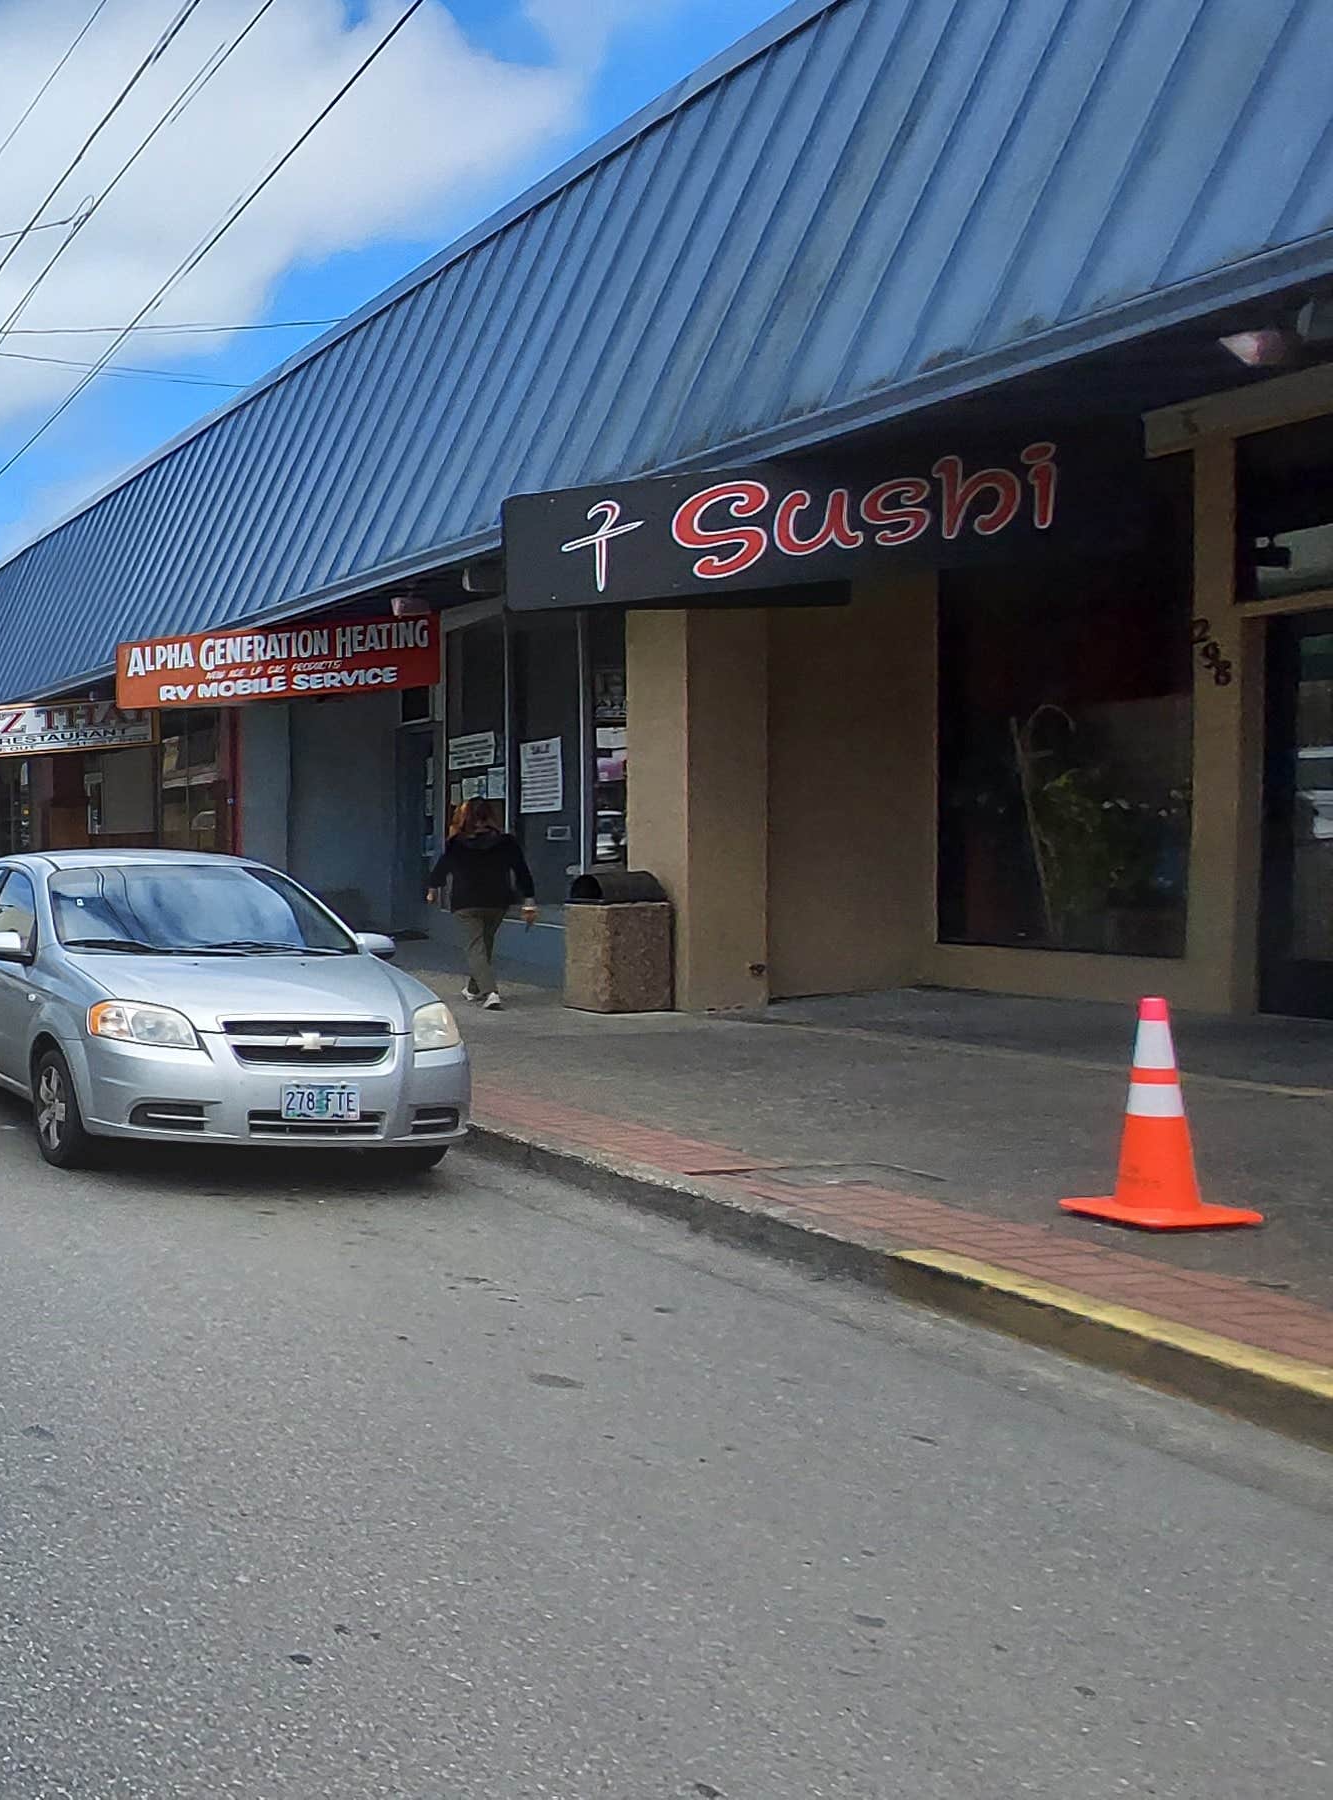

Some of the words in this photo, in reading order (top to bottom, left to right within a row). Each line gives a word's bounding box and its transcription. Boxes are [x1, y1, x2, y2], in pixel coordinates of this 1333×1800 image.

[672, 441, 1057, 579] Sushi
[127, 642, 194, 677] ALPHA
[199, 629, 329, 671] GENERATION
[336, 619, 429, 659] HEATING
[1189, 619, 1231, 686] 298
[291, 660, 342, 672] PRODUCTS
[159, 684, 194, 702] RV
[198, 675, 287, 699] MOBILE
[292, 667, 398, 690] SERVICE
[0, 728, 127, 745] RESTAURANT
[286, 1091, 315, 1111] 278
[326, 1091, 356, 1111] FTE
